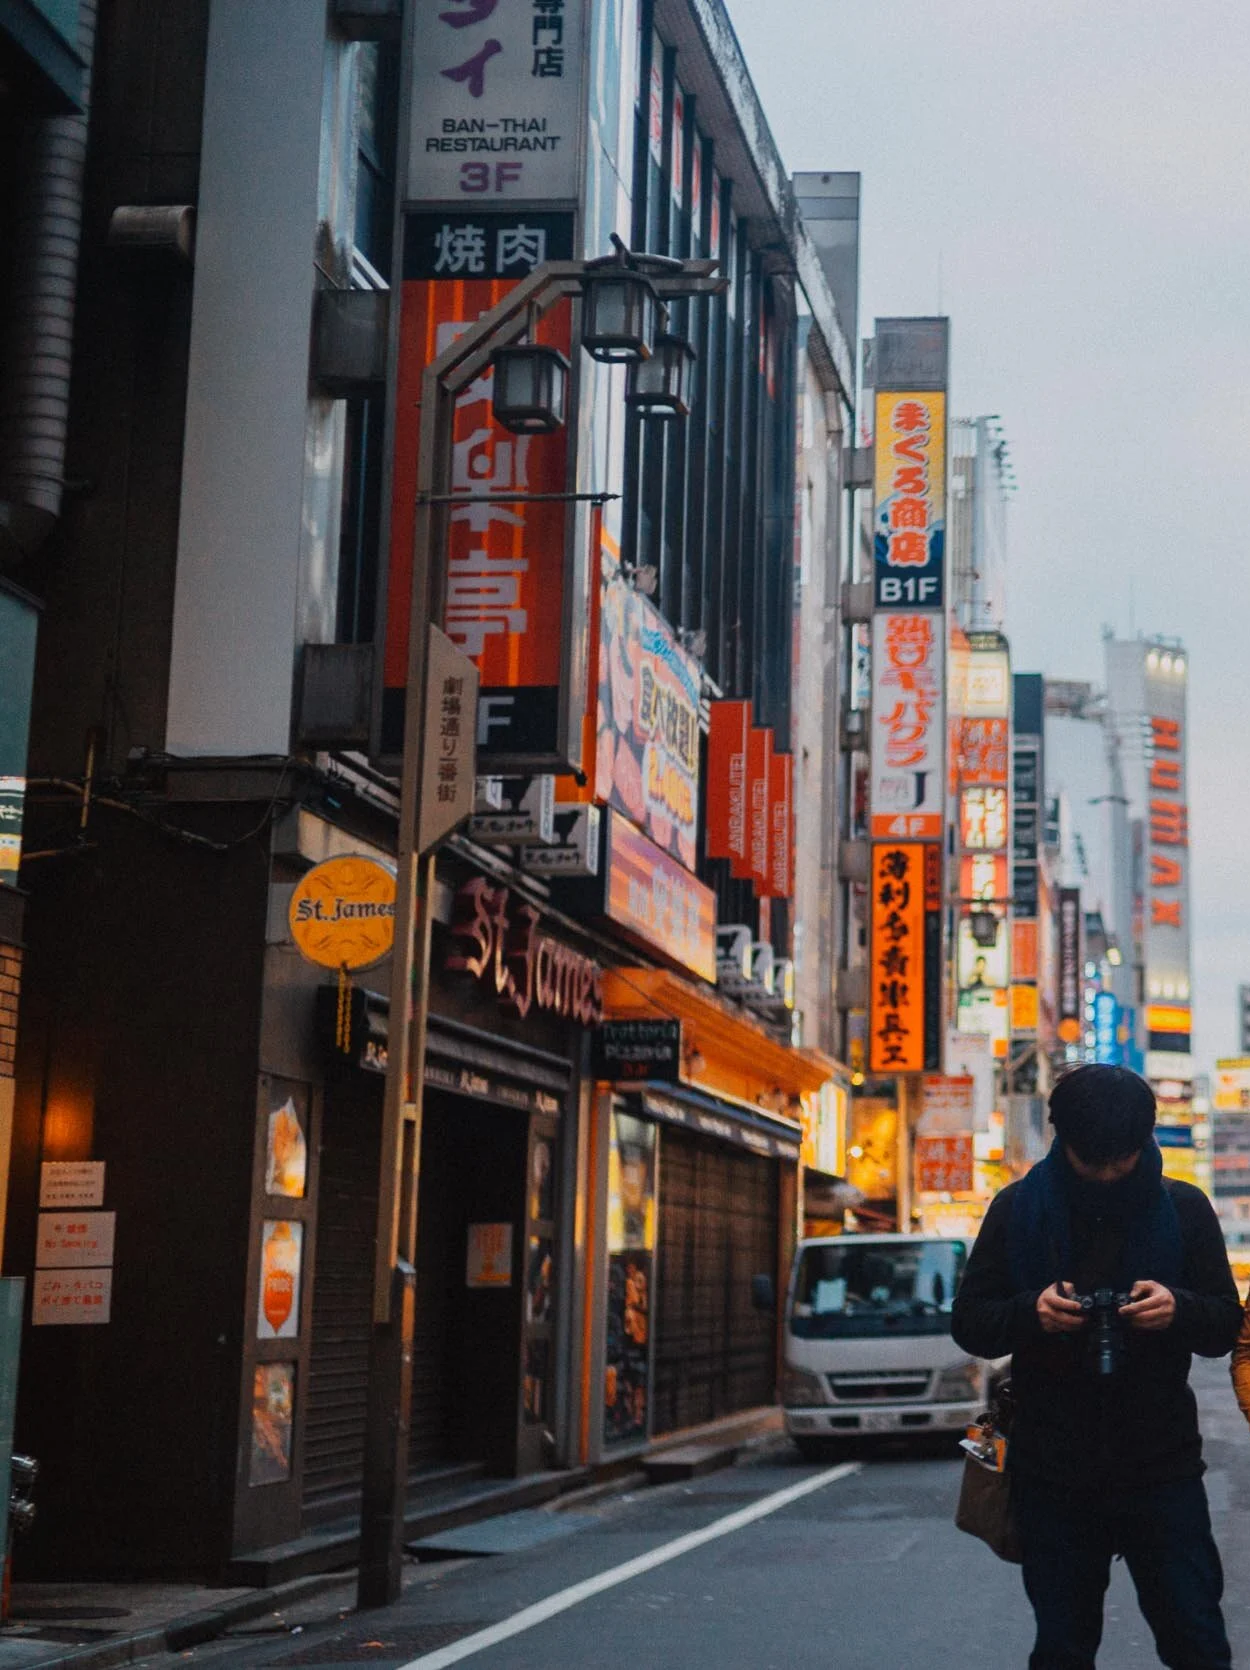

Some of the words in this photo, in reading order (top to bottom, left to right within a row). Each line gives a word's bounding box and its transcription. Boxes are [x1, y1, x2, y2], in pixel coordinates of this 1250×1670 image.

[425, 135, 561, 153] RESTAURANT
[442, 118, 547, 134] BAN-THAI
[459, 161, 523, 193] 3F
[434, 223, 546, 274] 焼肉
[437, 315, 531, 656] 楽亭
[880, 576, 938, 602] B1F
[437, 675, 463, 802] 劇場通り一番街
[478, 696, 515, 745] F
[887, 816, 926, 837] 4F
[1151, 717, 1187, 928] HUMAX
